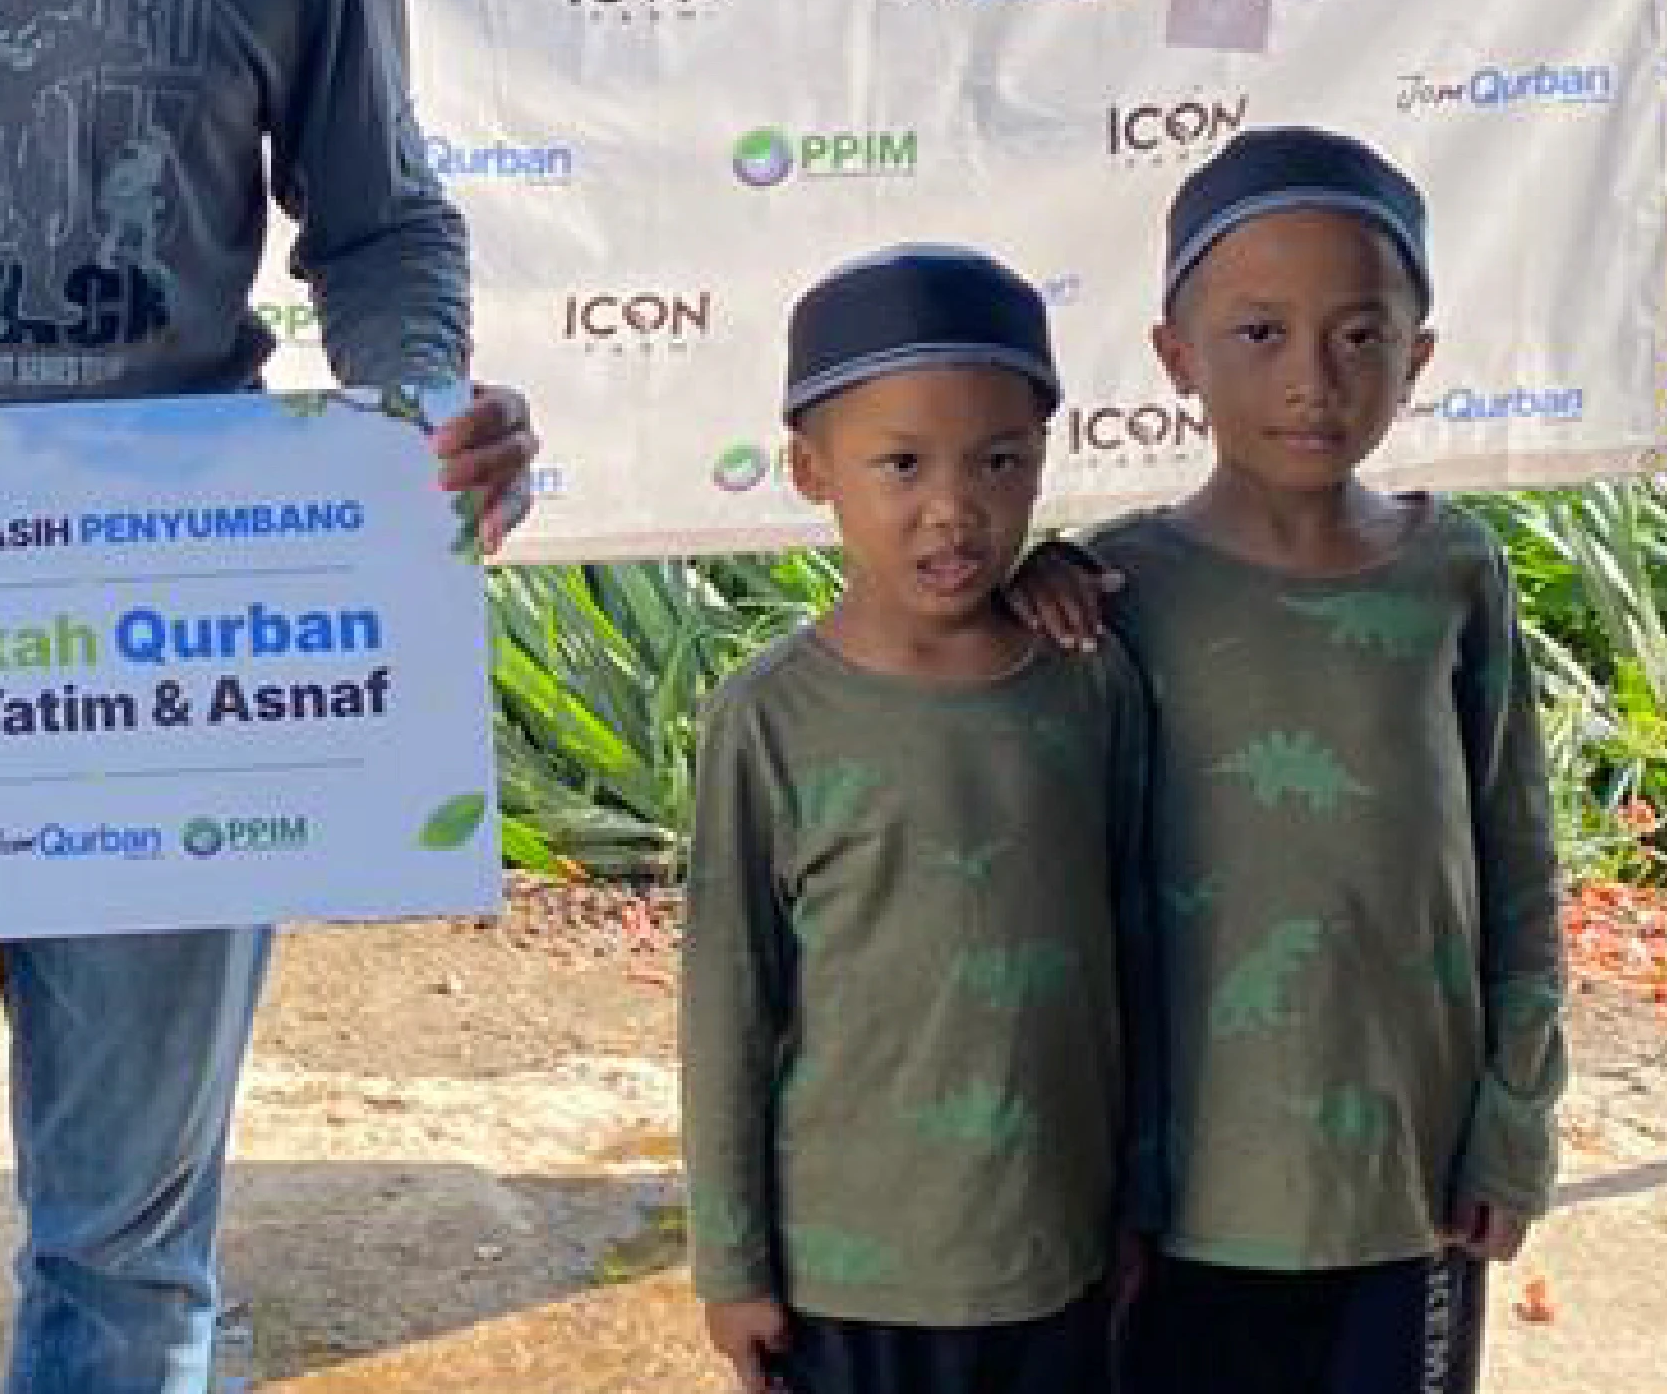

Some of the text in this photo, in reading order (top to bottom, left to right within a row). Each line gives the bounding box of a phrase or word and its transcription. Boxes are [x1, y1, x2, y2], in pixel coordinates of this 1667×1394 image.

[1109, 94, 1247, 155] ICON
[801, 131, 917, 168] PPIM
[564, 291, 711, 336] ICON
[1069, 405, 1210, 453] ICON
[81, 501, 365, 544] PENYUMBANG
[115, 604, 383, 665] Qurban
[152, 681, 190, 726] &
[208, 667, 392, 723] Asnaf
[226, 816, 308, 844] PPIM
